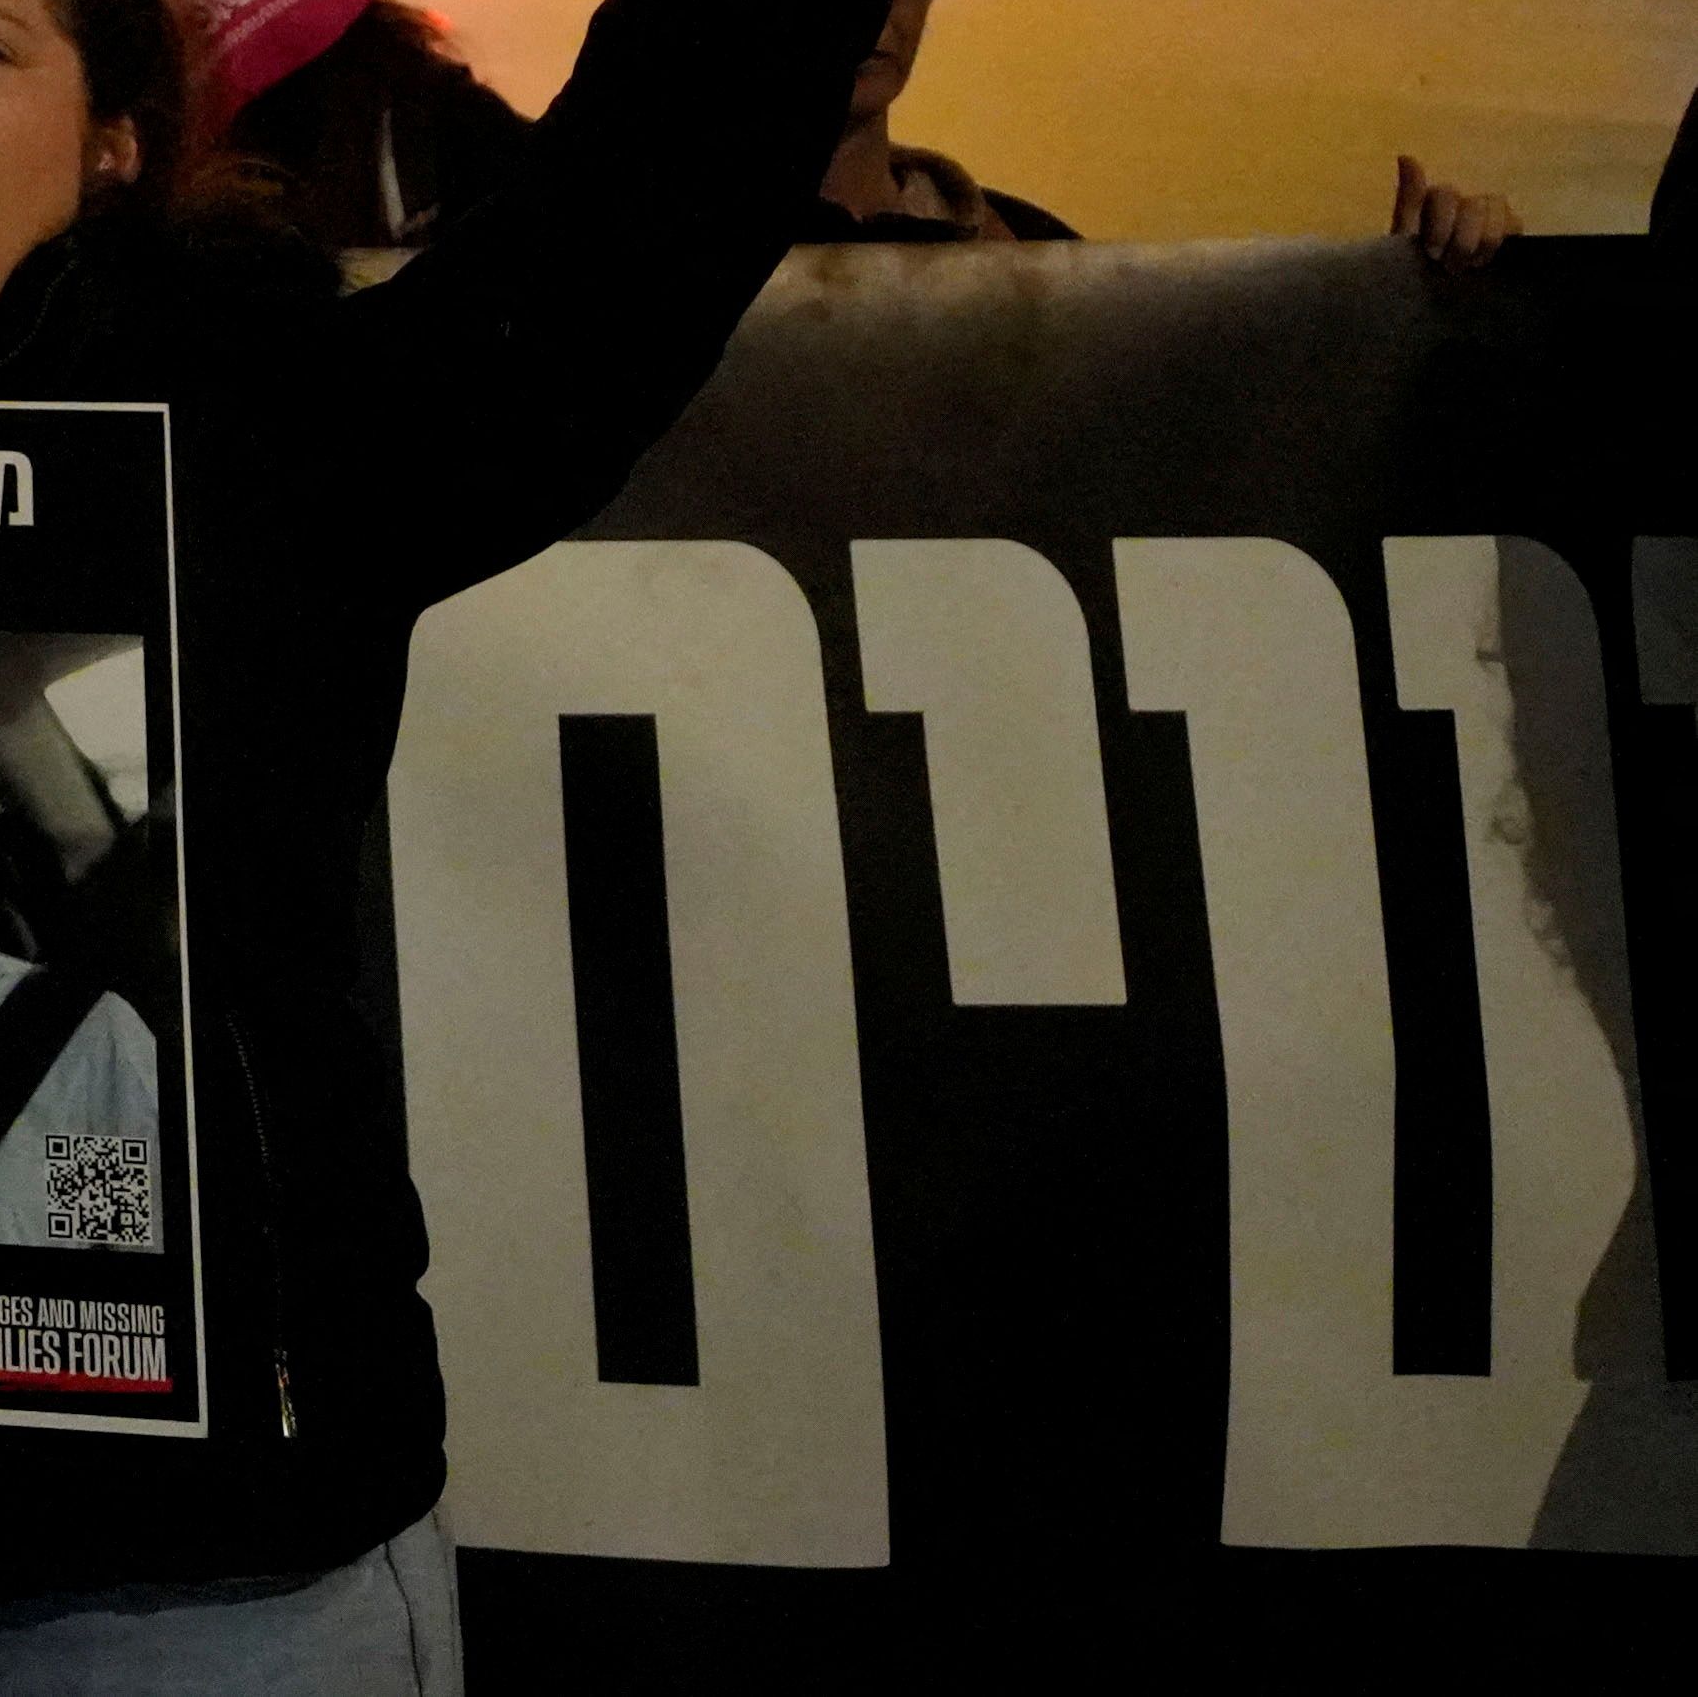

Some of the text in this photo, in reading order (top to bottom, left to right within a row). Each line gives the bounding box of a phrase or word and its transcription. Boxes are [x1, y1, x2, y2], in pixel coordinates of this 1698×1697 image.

[37, 1297, 76, 1329] AND
[79, 1300, 166, 1336] MISSING
[68, 1331, 167, 1382] FORUM
